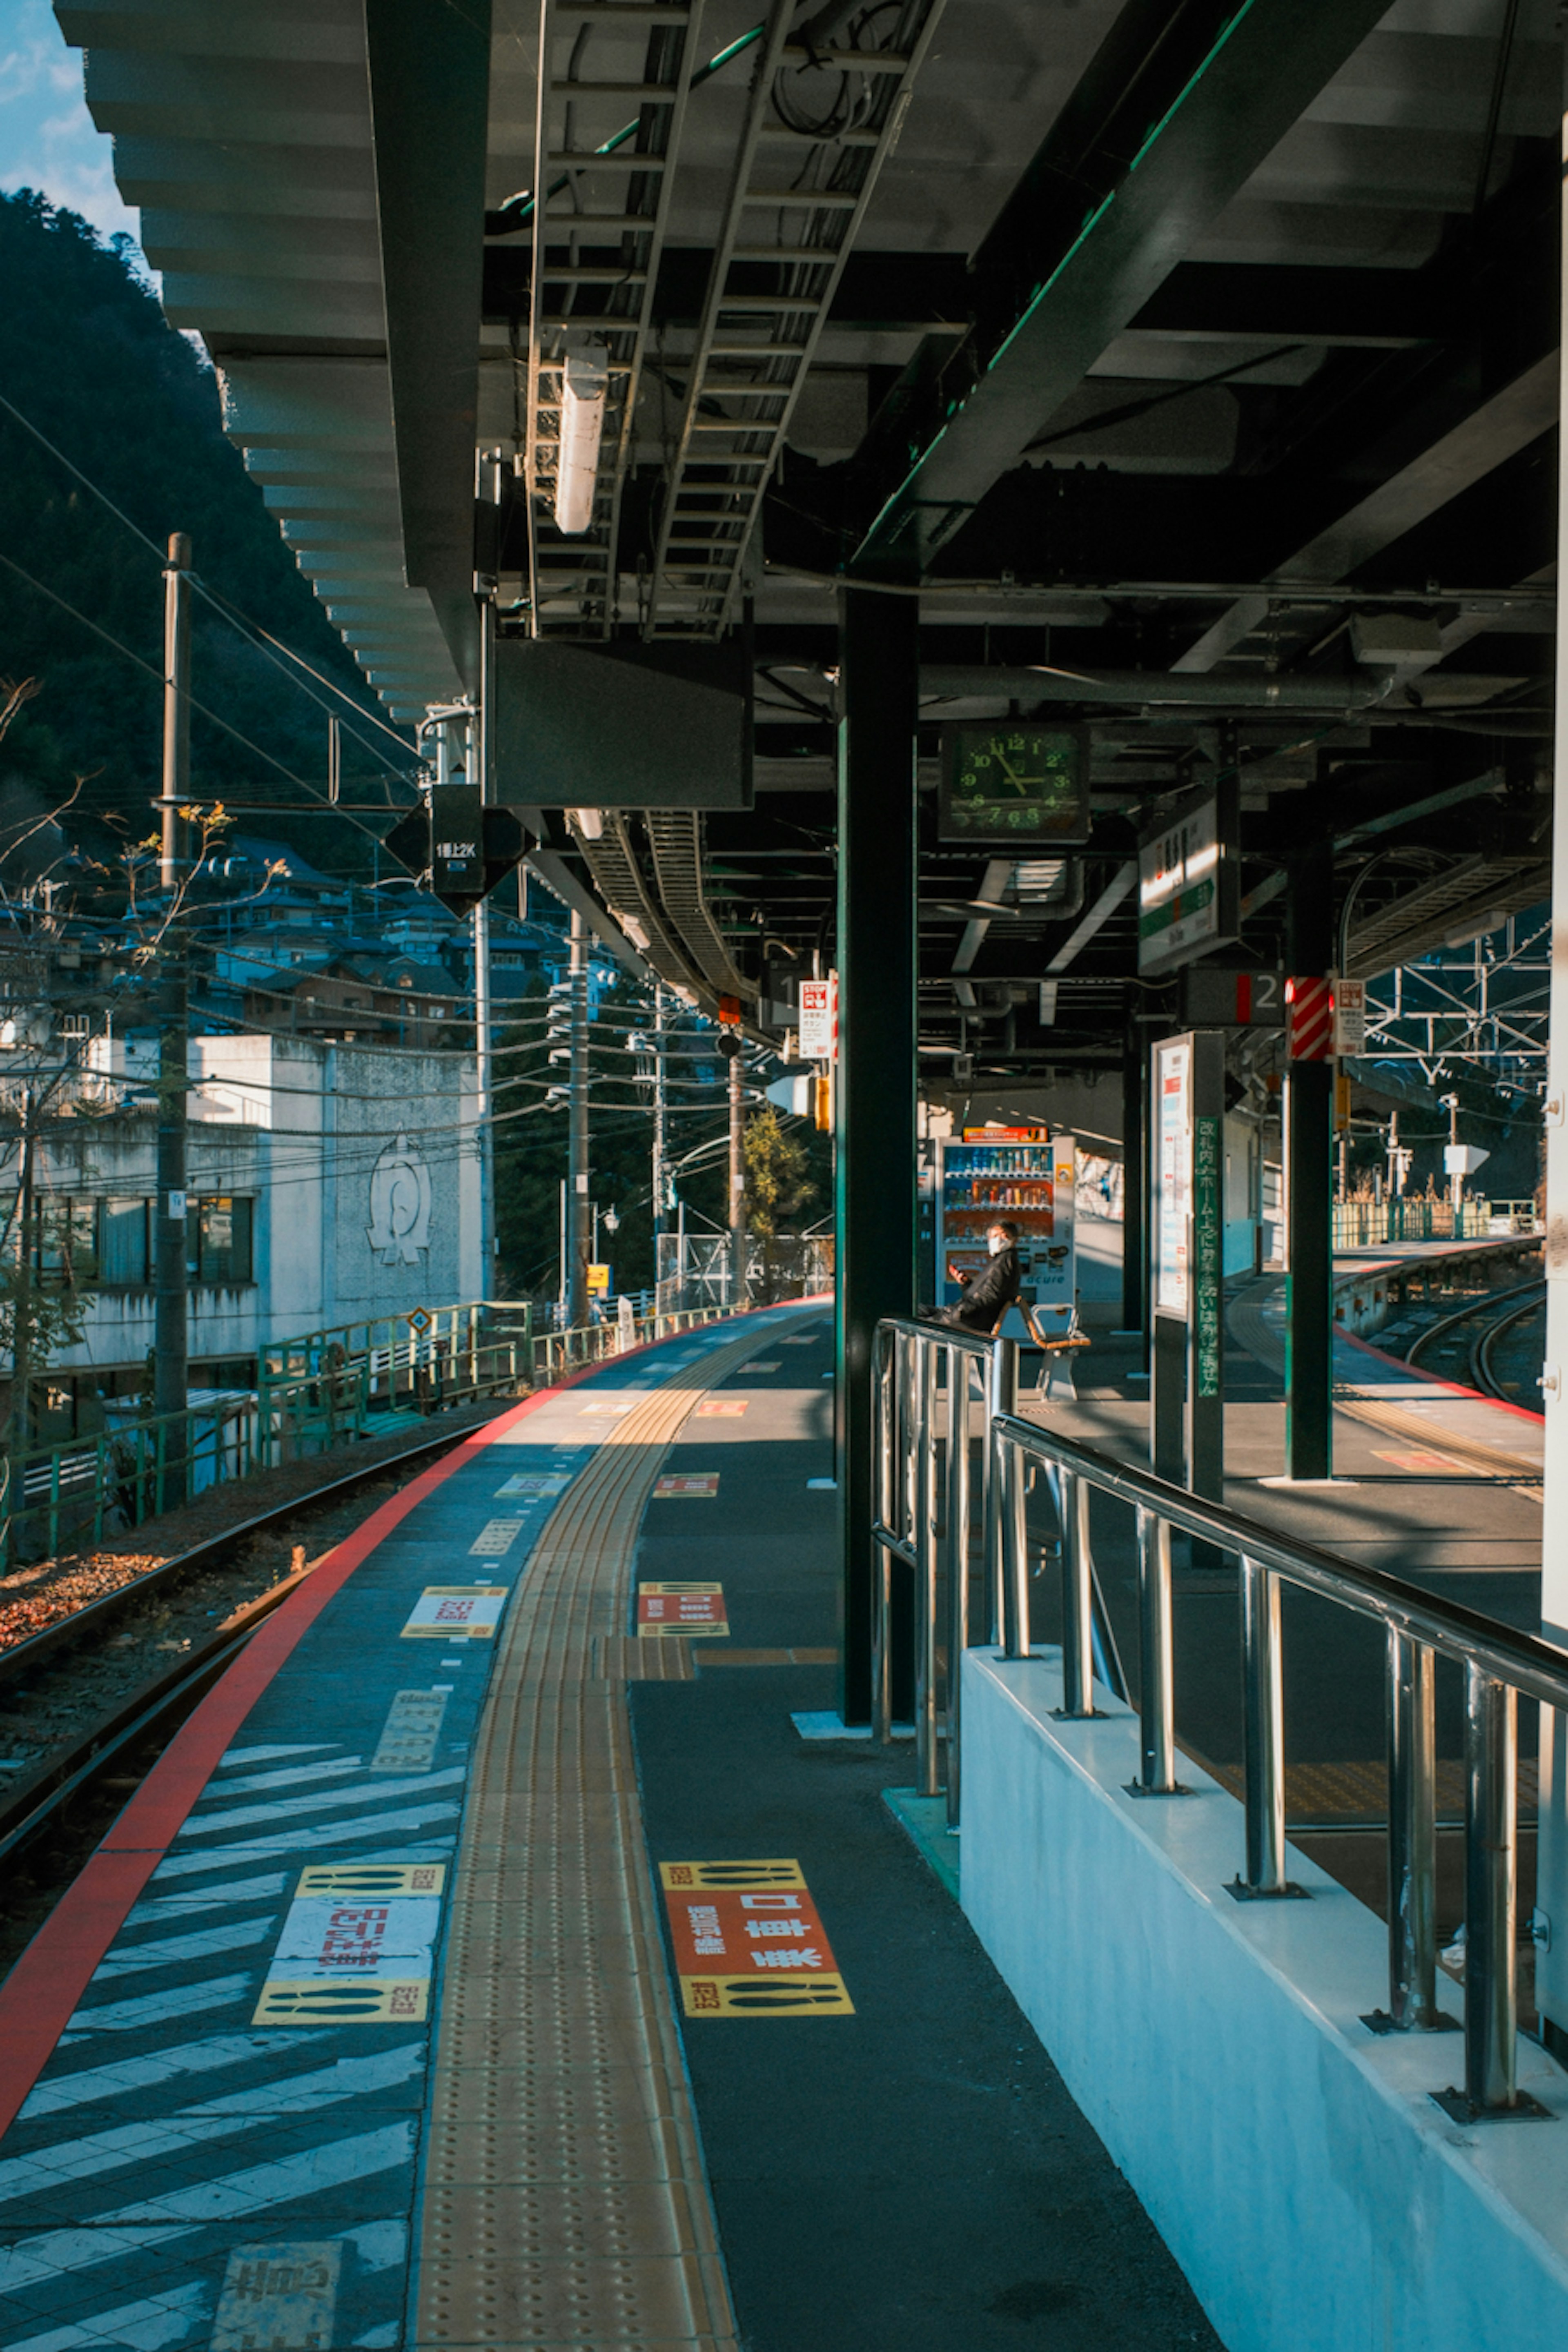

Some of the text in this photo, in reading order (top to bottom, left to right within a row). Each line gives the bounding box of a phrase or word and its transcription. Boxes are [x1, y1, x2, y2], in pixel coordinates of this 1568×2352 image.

[1007, 738, 1025, 750] 12
[1032, 743, 1039, 755] 1
[974, 755, 990, 767] 10
[1047, 755, 1058, 768] 2
[964, 774, 976, 786] 9
[1054, 776, 1066, 788] 3
[973, 794, 984, 806] 8
[1045, 796, 1057, 807] 4
[990, 807, 1001, 819] 7
[1008, 811, 1020, 823] 6
[1027, 808, 1038, 820] 5
[781, 976, 793, 1005] 1
[804, 985, 826, 993] STOP
[1256, 975, 1278, 1008] 2
[1027, 1276, 1065, 1285] acure
[740, 1894, 822, 1967] 乗車口
[318, 1908, 389, 1967] 足元注意
